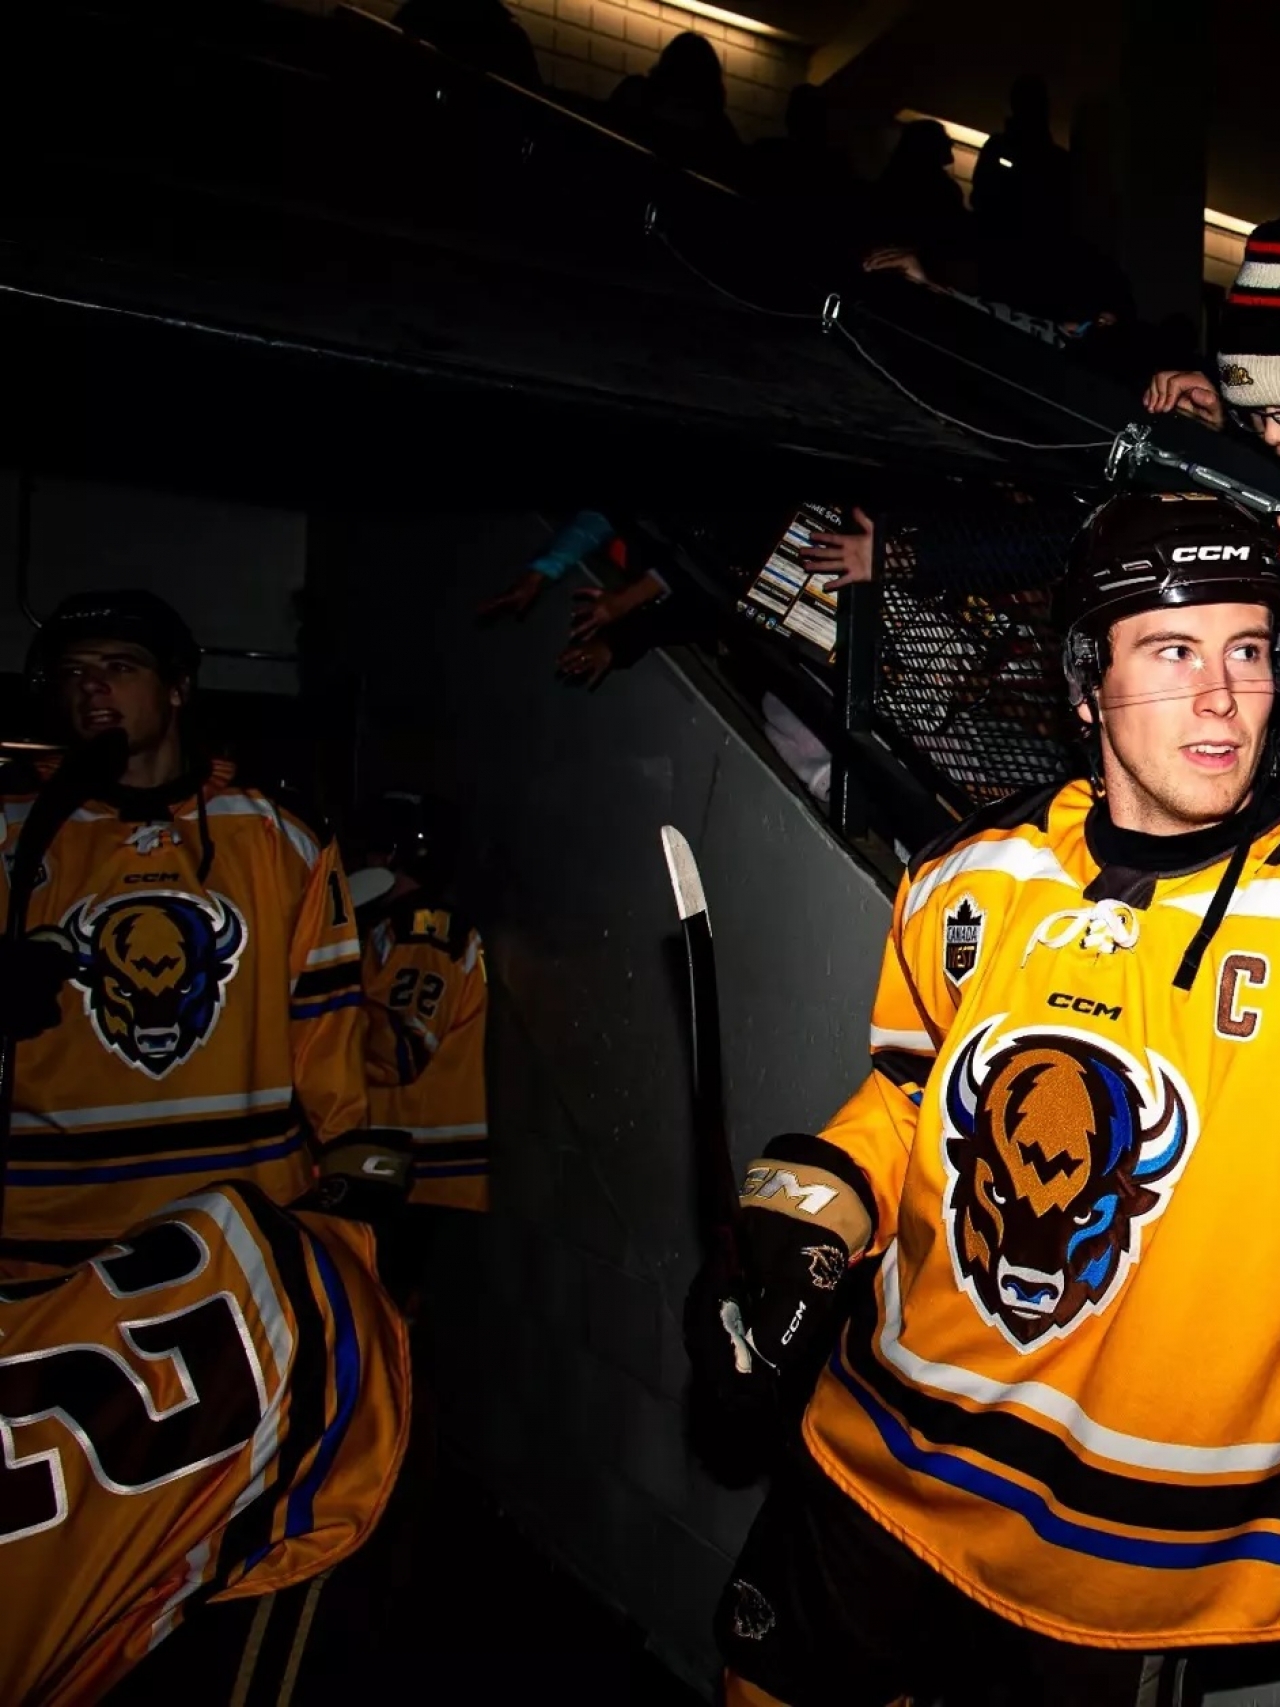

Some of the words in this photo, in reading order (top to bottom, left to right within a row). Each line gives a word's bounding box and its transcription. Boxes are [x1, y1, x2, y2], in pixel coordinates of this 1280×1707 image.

[1172, 544, 1250, 563] CCM
[124, 873, 179, 884] CCM
[947, 926, 978, 943] CANADA
[948, 945, 975, 969] WEST
[388, 967, 446, 1019] 22
[1215, 952, 1269, 1040] C
[1047, 992, 1123, 1021] CCM
[781, 1300, 806, 1345] CCM
